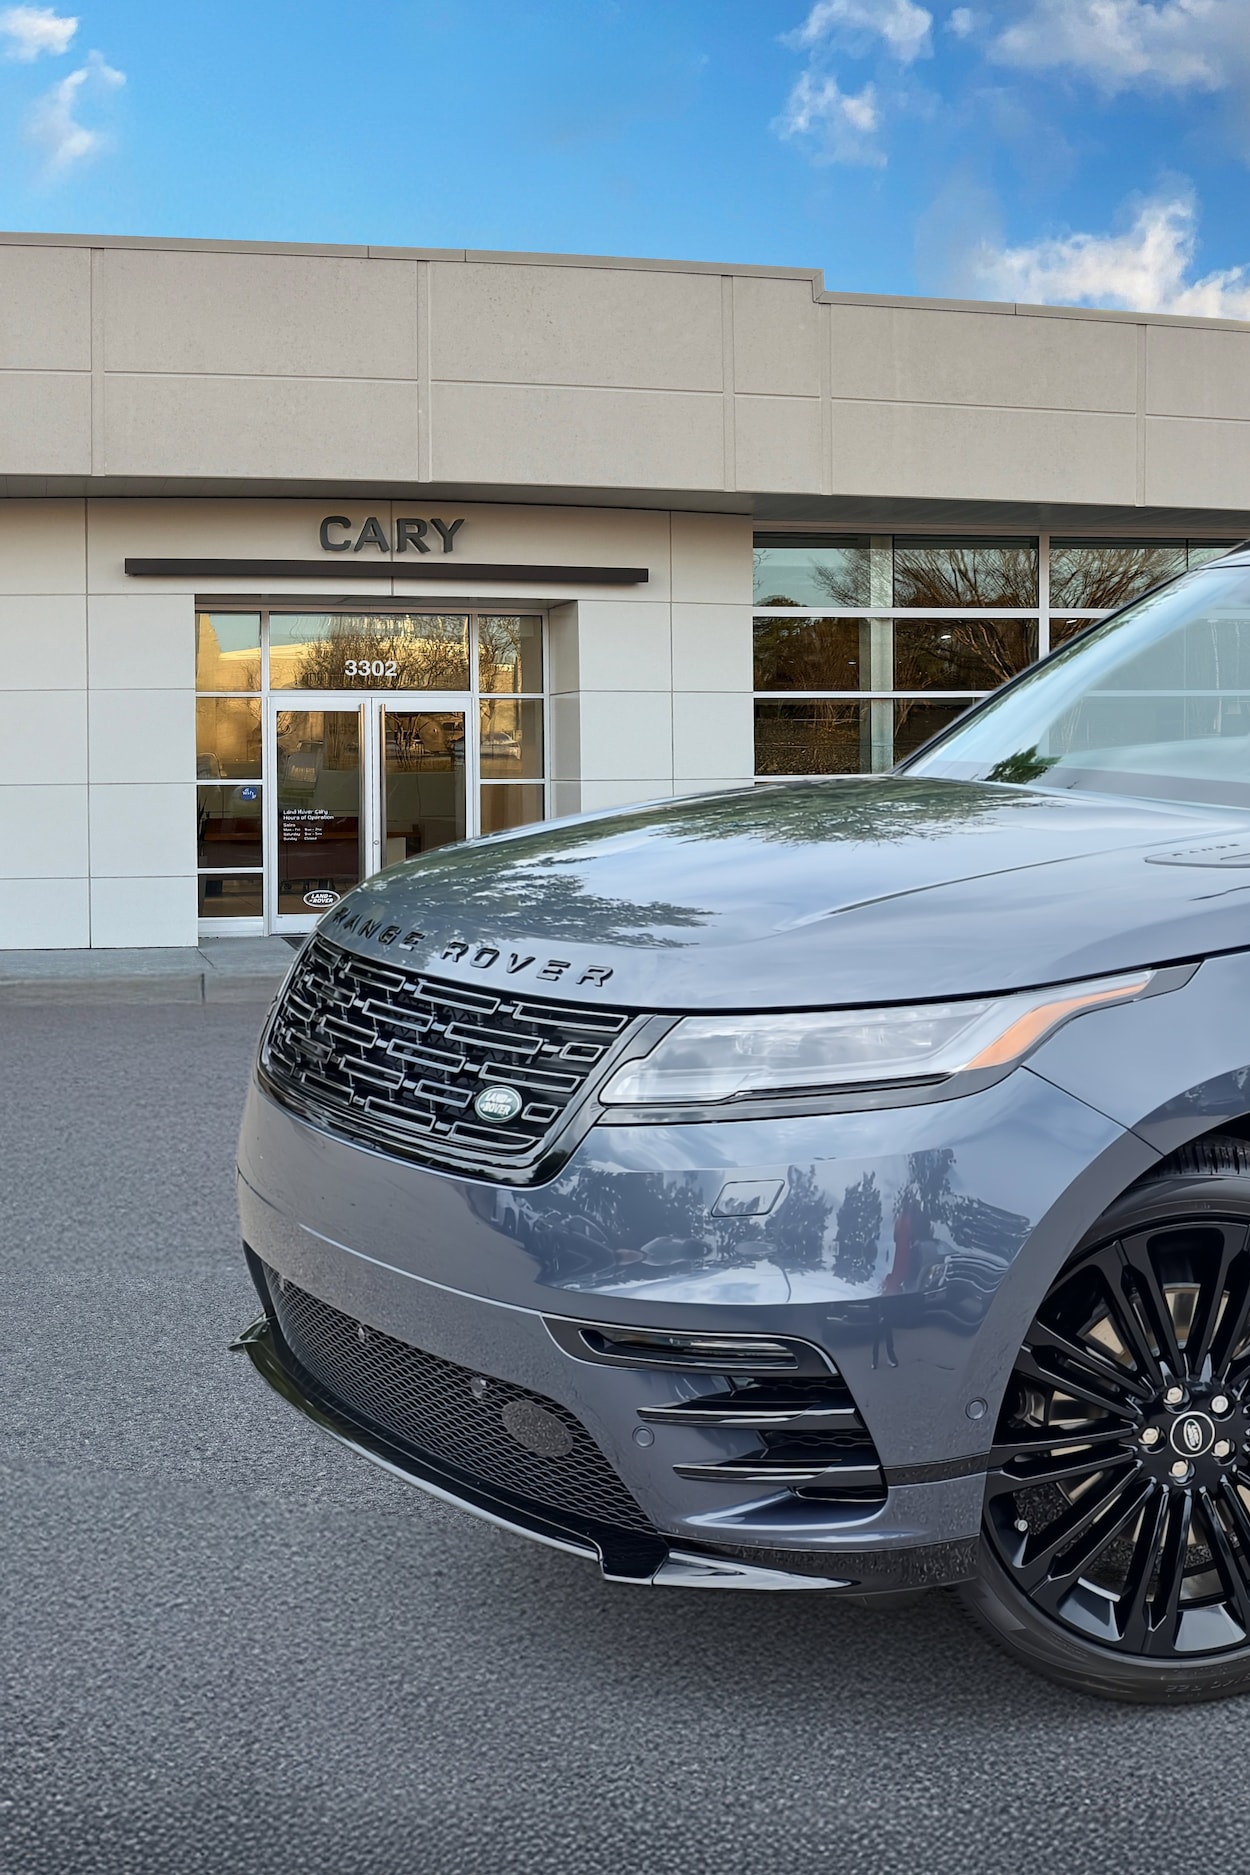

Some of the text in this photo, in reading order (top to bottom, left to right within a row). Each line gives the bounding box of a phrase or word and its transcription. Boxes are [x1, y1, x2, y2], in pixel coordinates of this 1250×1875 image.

[319, 515, 465, 554] CARY
[344, 659, 398, 678] 3302
[330, 906, 614, 988] RANGE ROVER
